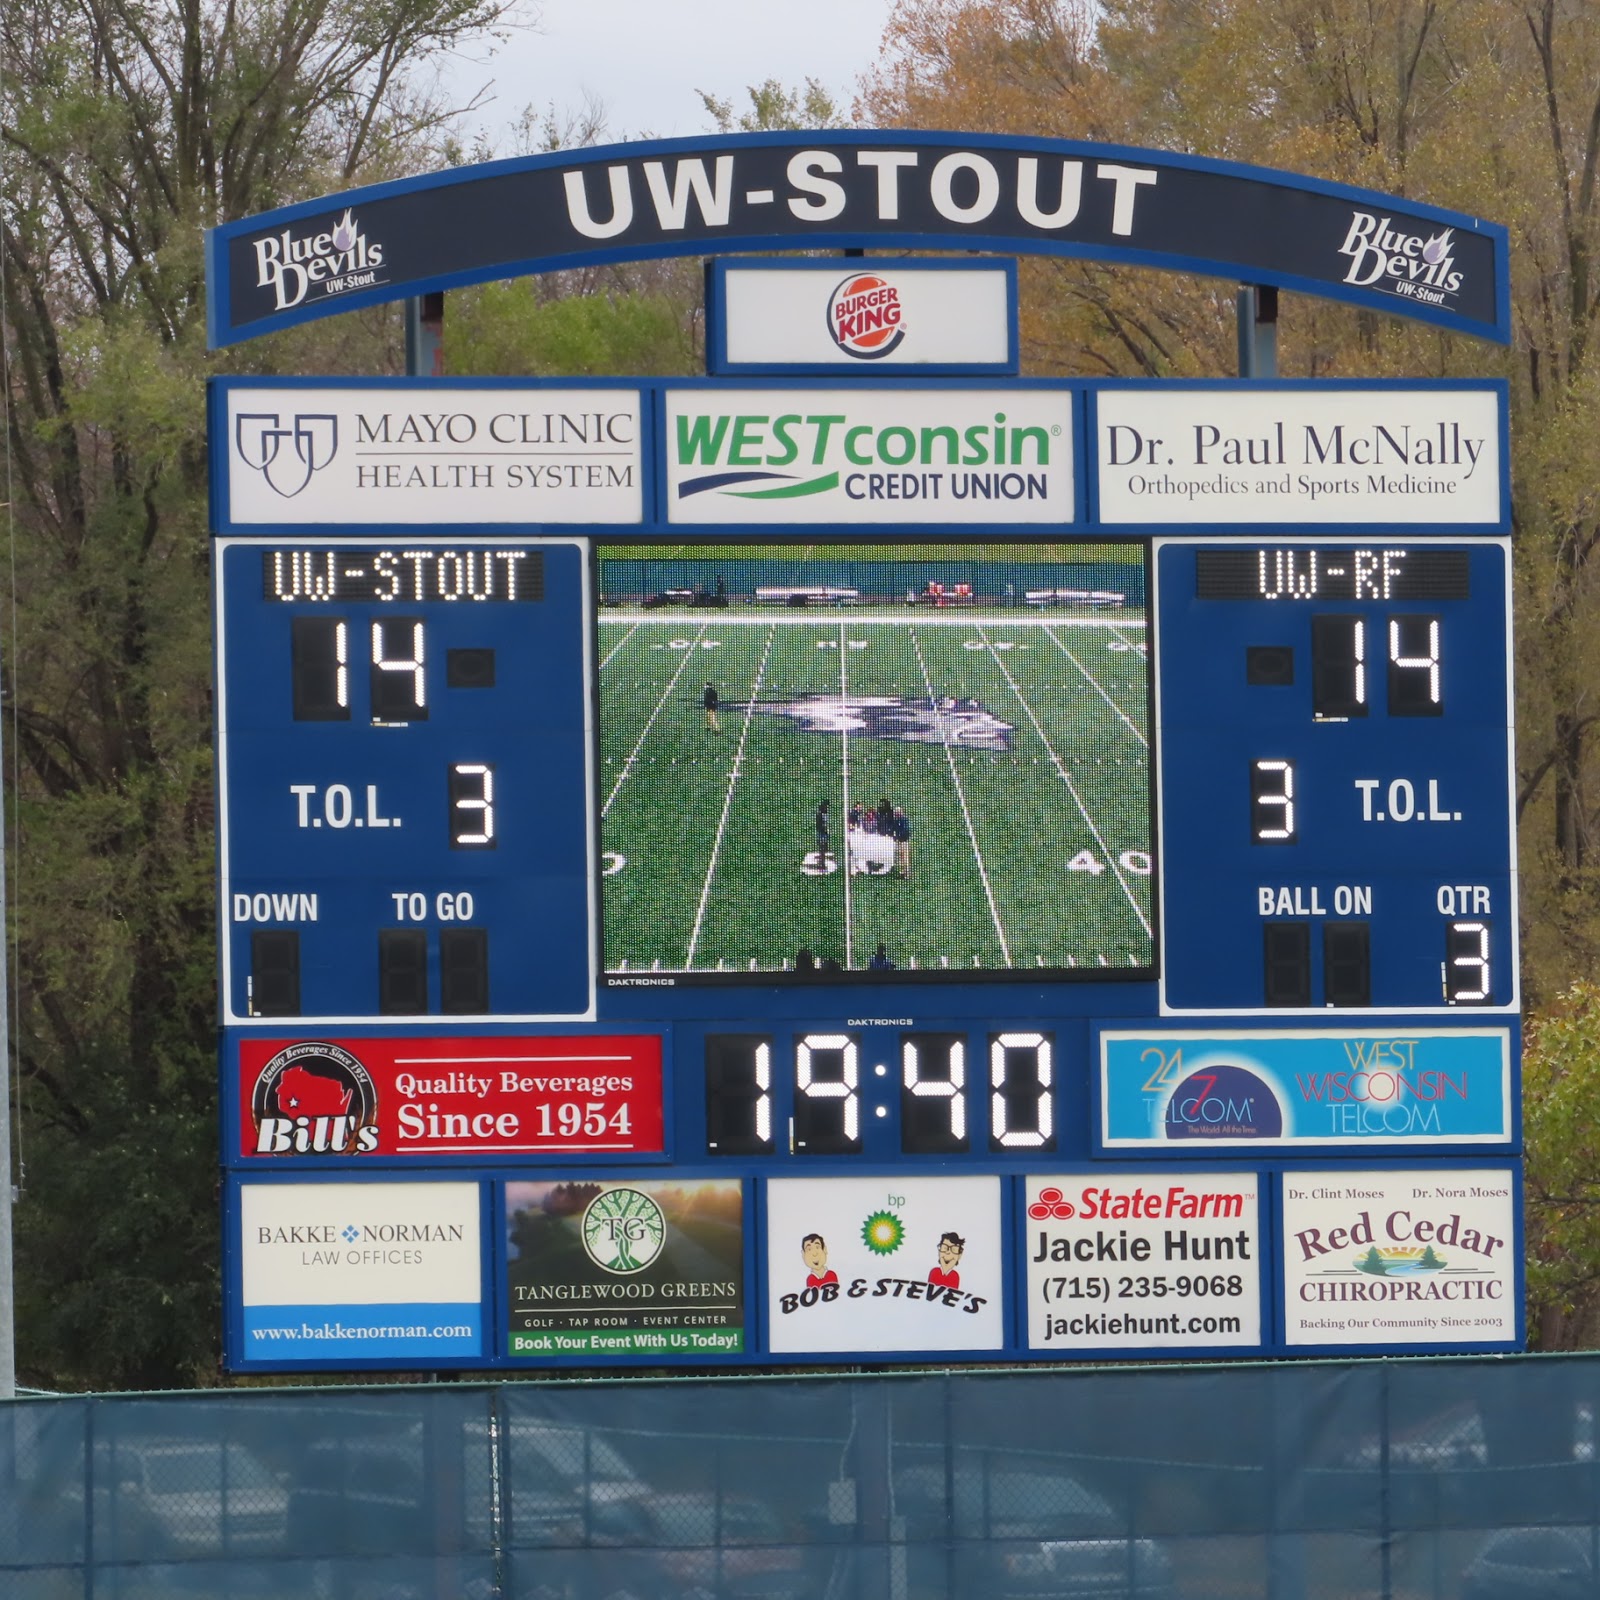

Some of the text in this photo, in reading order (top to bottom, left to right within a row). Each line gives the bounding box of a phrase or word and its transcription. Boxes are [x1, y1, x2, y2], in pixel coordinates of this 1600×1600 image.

[563, 150, 1158, 239] UW-STOUT
[1337, 211, 1424, 257] Blue
[253, 229, 332, 287] Blue
[274, 233, 383, 310] Devils
[1342, 245, 1464, 291] Devils
[326, 271, 376, 293] UW-Stout
[1396, 281, 1445, 304] UW-Stout
[836, 287, 898, 320] BURGER
[839, 303, 901, 342] KING
[356, 413, 634, 444] MAYO CLINIC
[1106, 421, 1485, 479] Dr. Paul McNally
[356, 464, 634, 489] HEALTH SYSTEM
[845, 473, 1047, 500] CREDIT UNION
[1128, 474, 1457, 501] Orthopedics and Sports Medicine
[274, 551, 527, 601] UW-STOUT
[1258, 550, 1406, 600] UW-RF
[334, 622, 426, 708] 14
[1354, 620, 1440, 704] 14
[290, 783, 402, 828] T.O.L.
[455, 764, 494, 844] 3
[1256, 761, 1294, 839] 3
[1354, 778, 1463, 822] T.O.L.
[233, 893, 318, 922] DOWN
[391, 892, 474, 921] TO GO
[1258, 885, 1373, 916] BALL ON
[1437, 885, 1491, 917] QTR
[1452, 922, 1490, 1001] 3
[607, 978, 675, 987] DAKTRONICS
[847, 1018, 914, 1027] DAKTRONICS
[261, 1055, 286, 1084] Quality
[285, 1046, 328, 1060] Beverages
[328, 1047, 352, 1066] Since
[1140, 1047, 1182, 1092] 24
[1343, 1040, 1419, 1070] WEST
[395, 1071, 634, 1099] Quality Beverages
[754, 1032, 1054, 1147] 19:40
[1295, 1071, 1467, 1101] WISCONSIN
[397, 1101, 632, 1140] Since 1954
[1326, 1103, 1441, 1133] TELCOM
[256, 1115, 379, 1153] Bill's
[888, 1193, 906, 1209] bp
[1288, 1187, 1385, 1200] Dr. Clint Moses
[1412, 1186, 1509, 1199] Dr. Nora Moses
[257, 1223, 464, 1244] BAKKE NORMAN
[601, 1217, 646, 1241] TG
[1293, 1210, 1504, 1262] Red Cedar
[302, 1249, 423, 1265] LAW OFFICES
[1033, 1230, 1251, 1263] Jackie Hunt
[514, 1282, 736, 1300] TANGLEWOOD GREENS
[779, 1277, 988, 1315] BOB & STEVE'S
[1042, 1275, 1243, 1304] (715) 235-9068
[1299, 1279, 1503, 1302] CHIROPRACTIC
[251, 1322, 473, 1341] www.bakkenorman.com
[524, 1315, 727, 1328] GOLF TAP ROOM EVENT CENTER
[1044, 1312, 1241, 1341] jackiehunt.com
[1299, 1316, 1503, 1330] Backing Our Community Since 2003
[514, 1332, 739, 1351] Book Your Event With Us Today!
